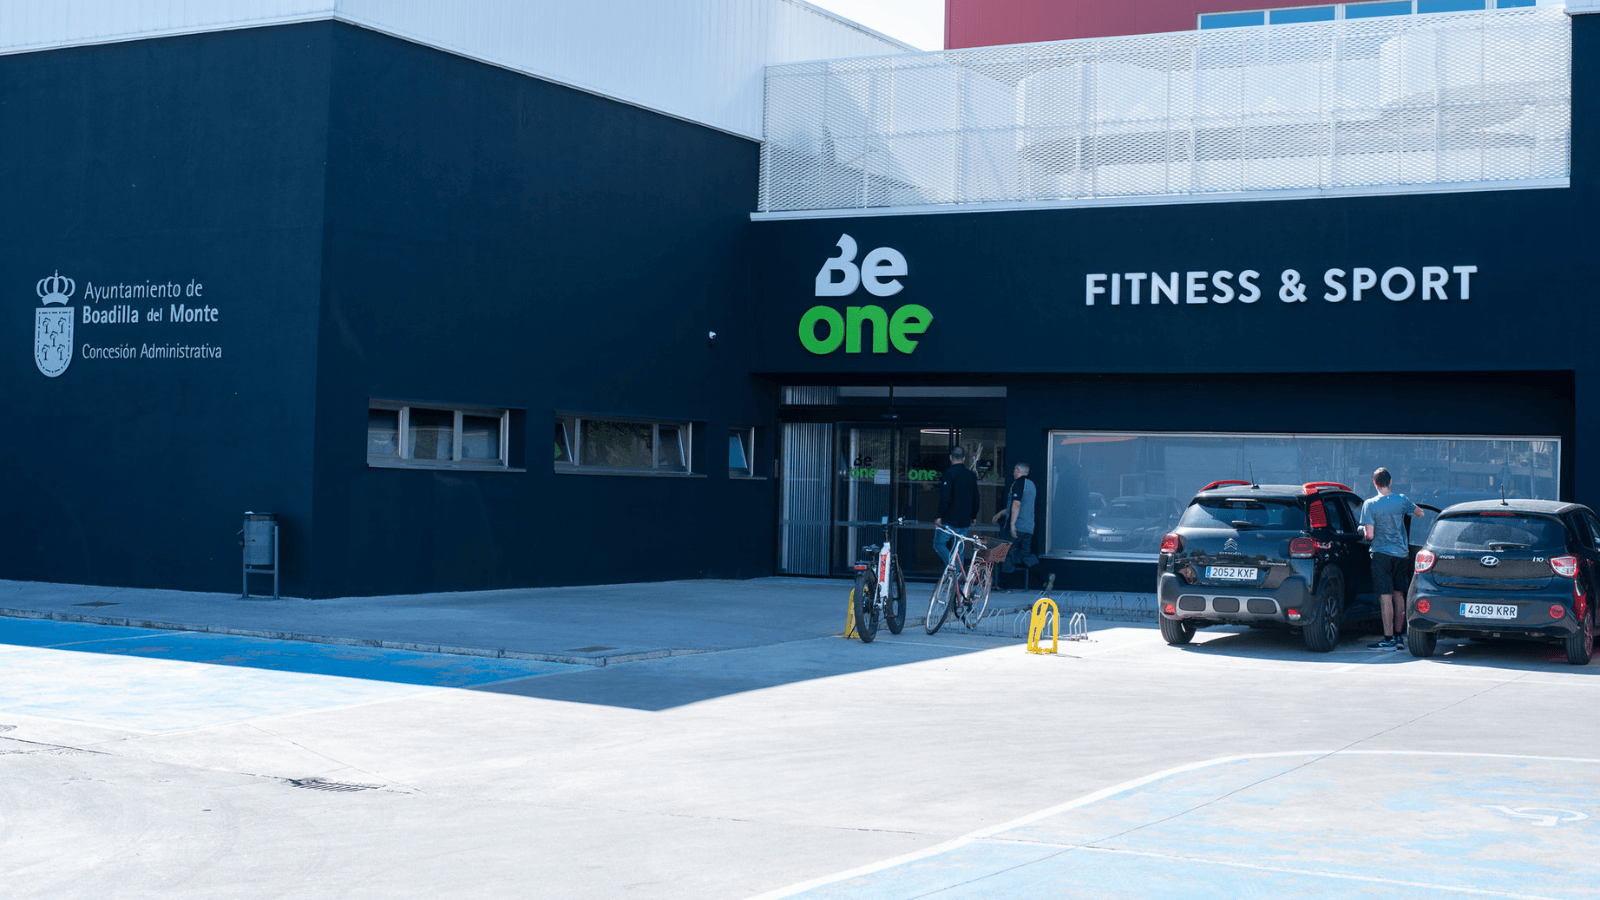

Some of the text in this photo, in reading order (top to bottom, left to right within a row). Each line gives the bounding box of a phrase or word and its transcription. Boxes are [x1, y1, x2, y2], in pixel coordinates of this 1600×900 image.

[814, 233, 909, 297] Be
[84, 278, 203, 303] Ayuntamiento de
[1085, 265, 1479, 306] FITNESS & SPORT
[82, 303, 219, 324] Boadilla del Monte
[798, 303, 935, 355] one
[82, 342, 222, 359] Concesión Administrativa
[850, 468, 878, 479] one
[908, 469, 938, 481] one
[1212, 567, 1256, 578] 2052 KXF
[1468, 604, 1516, 617] 4309 KRR
